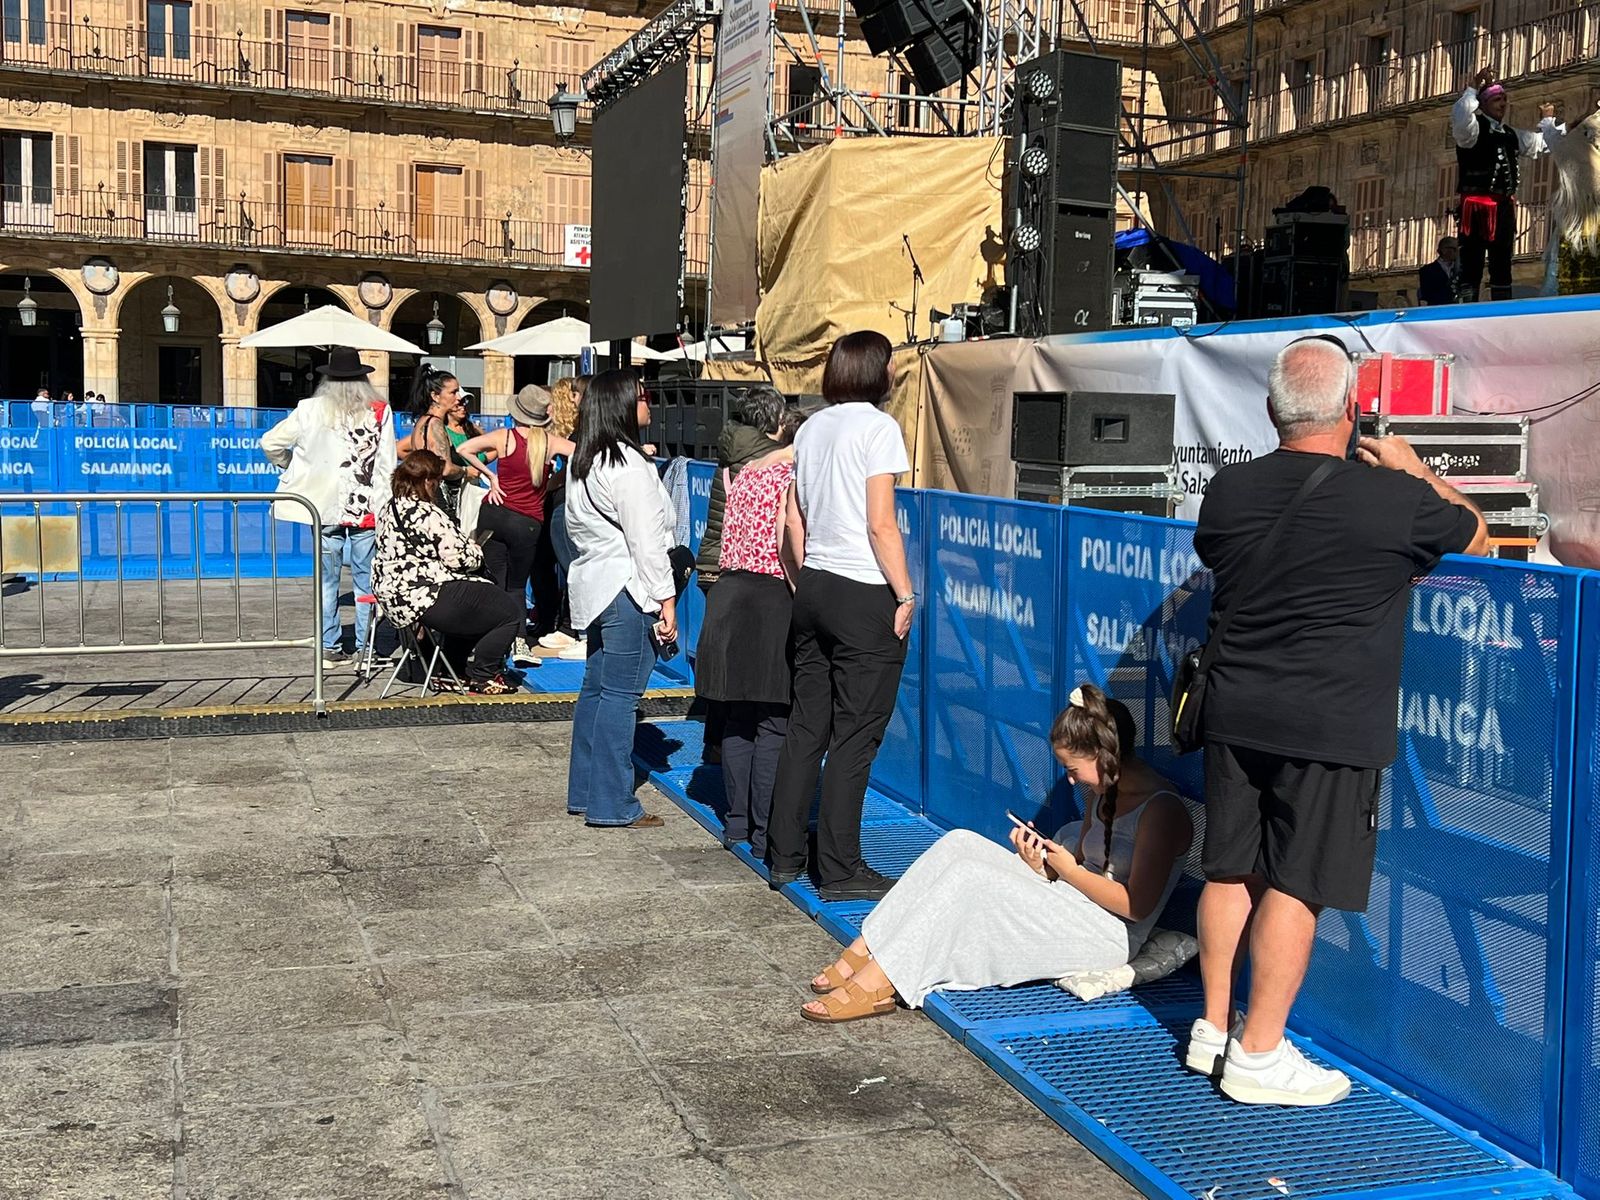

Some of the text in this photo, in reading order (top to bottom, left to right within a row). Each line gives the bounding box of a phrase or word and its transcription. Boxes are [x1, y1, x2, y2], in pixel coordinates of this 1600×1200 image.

[0, 436, 38, 449] OCAL
[133, 437, 177, 450] LOCAL
[1174, 441, 1252, 469] yuntamiento
[81, 462, 172, 475] SALAMANCA
[692, 476, 711, 499] POLIC
[1181, 470, 1209, 496] Sala
[940, 513, 991, 549] POLICIA
[994, 521, 1042, 559] LOCAL
[1081, 536, 1153, 581] POLICIA
[944, 576, 1035, 628] SALAMANCA
[1412, 590, 1523, 650] LOCAL
[1398, 686, 1505, 755] ANCA
